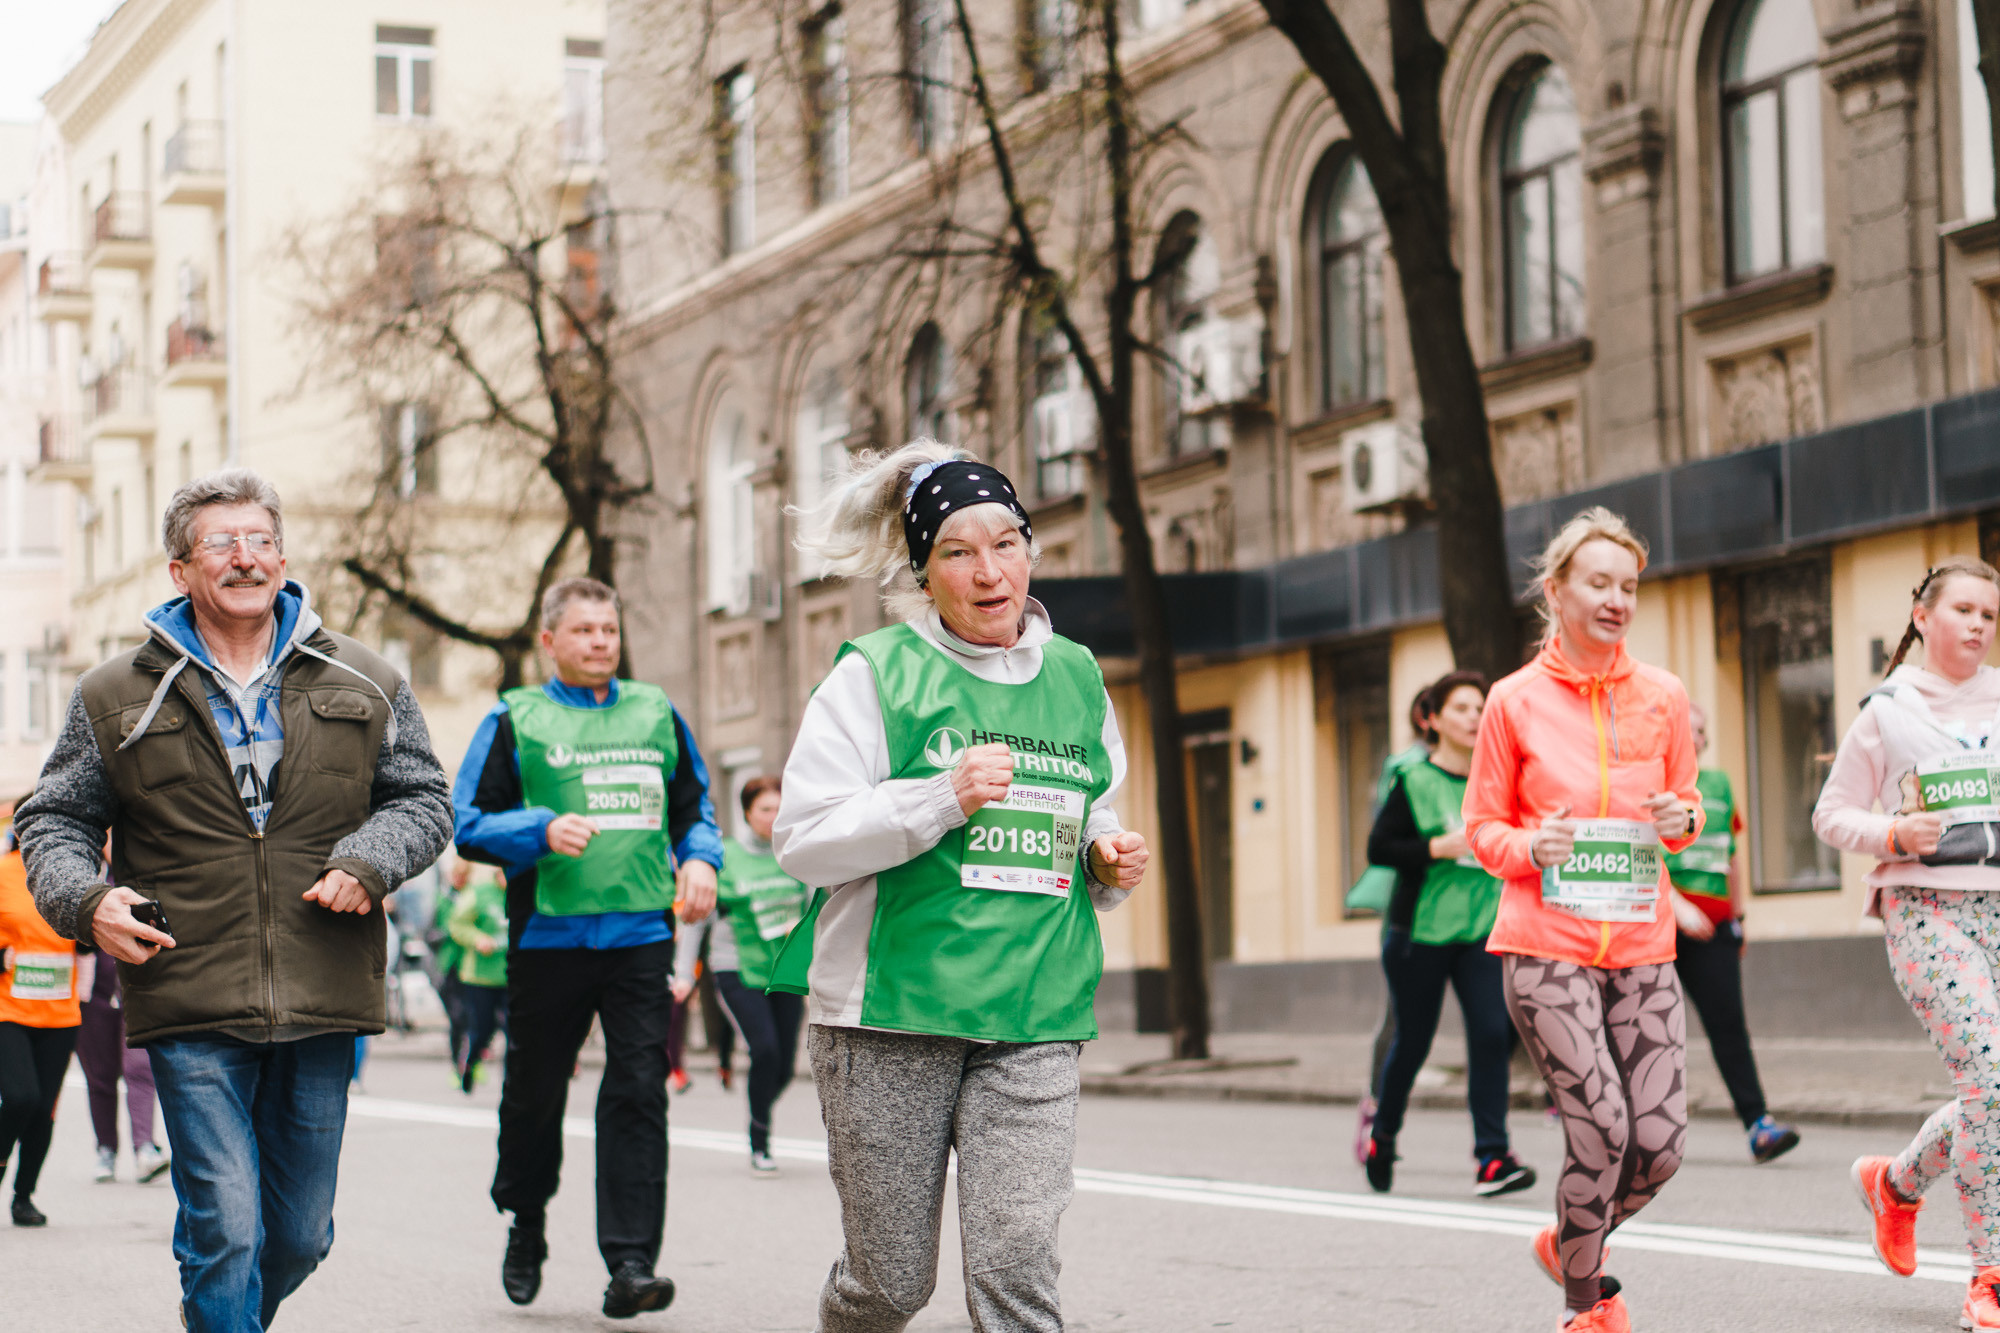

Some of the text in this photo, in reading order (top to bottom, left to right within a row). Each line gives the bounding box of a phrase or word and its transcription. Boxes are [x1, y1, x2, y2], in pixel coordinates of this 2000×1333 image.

[971, 729, 1088, 765] HERBALIFE
[575, 749, 664, 764] NUTRITION
[1009, 751, 1094, 783] TRITION
[587, 791, 640, 809] 20570
[1012, 790, 1066, 803] HERBALIFE
[1925, 779, 1988, 804] 20493
[1012, 799, 1066, 812] NUTRITION
[1056, 821, 1077, 833] FAMILY
[968, 826, 1051, 856] 20183
[1056, 830, 1076, 847] RUN
[1055, 849, 1074, 861] 1,6 KM
[1563, 852, 1630, 874] 20462
